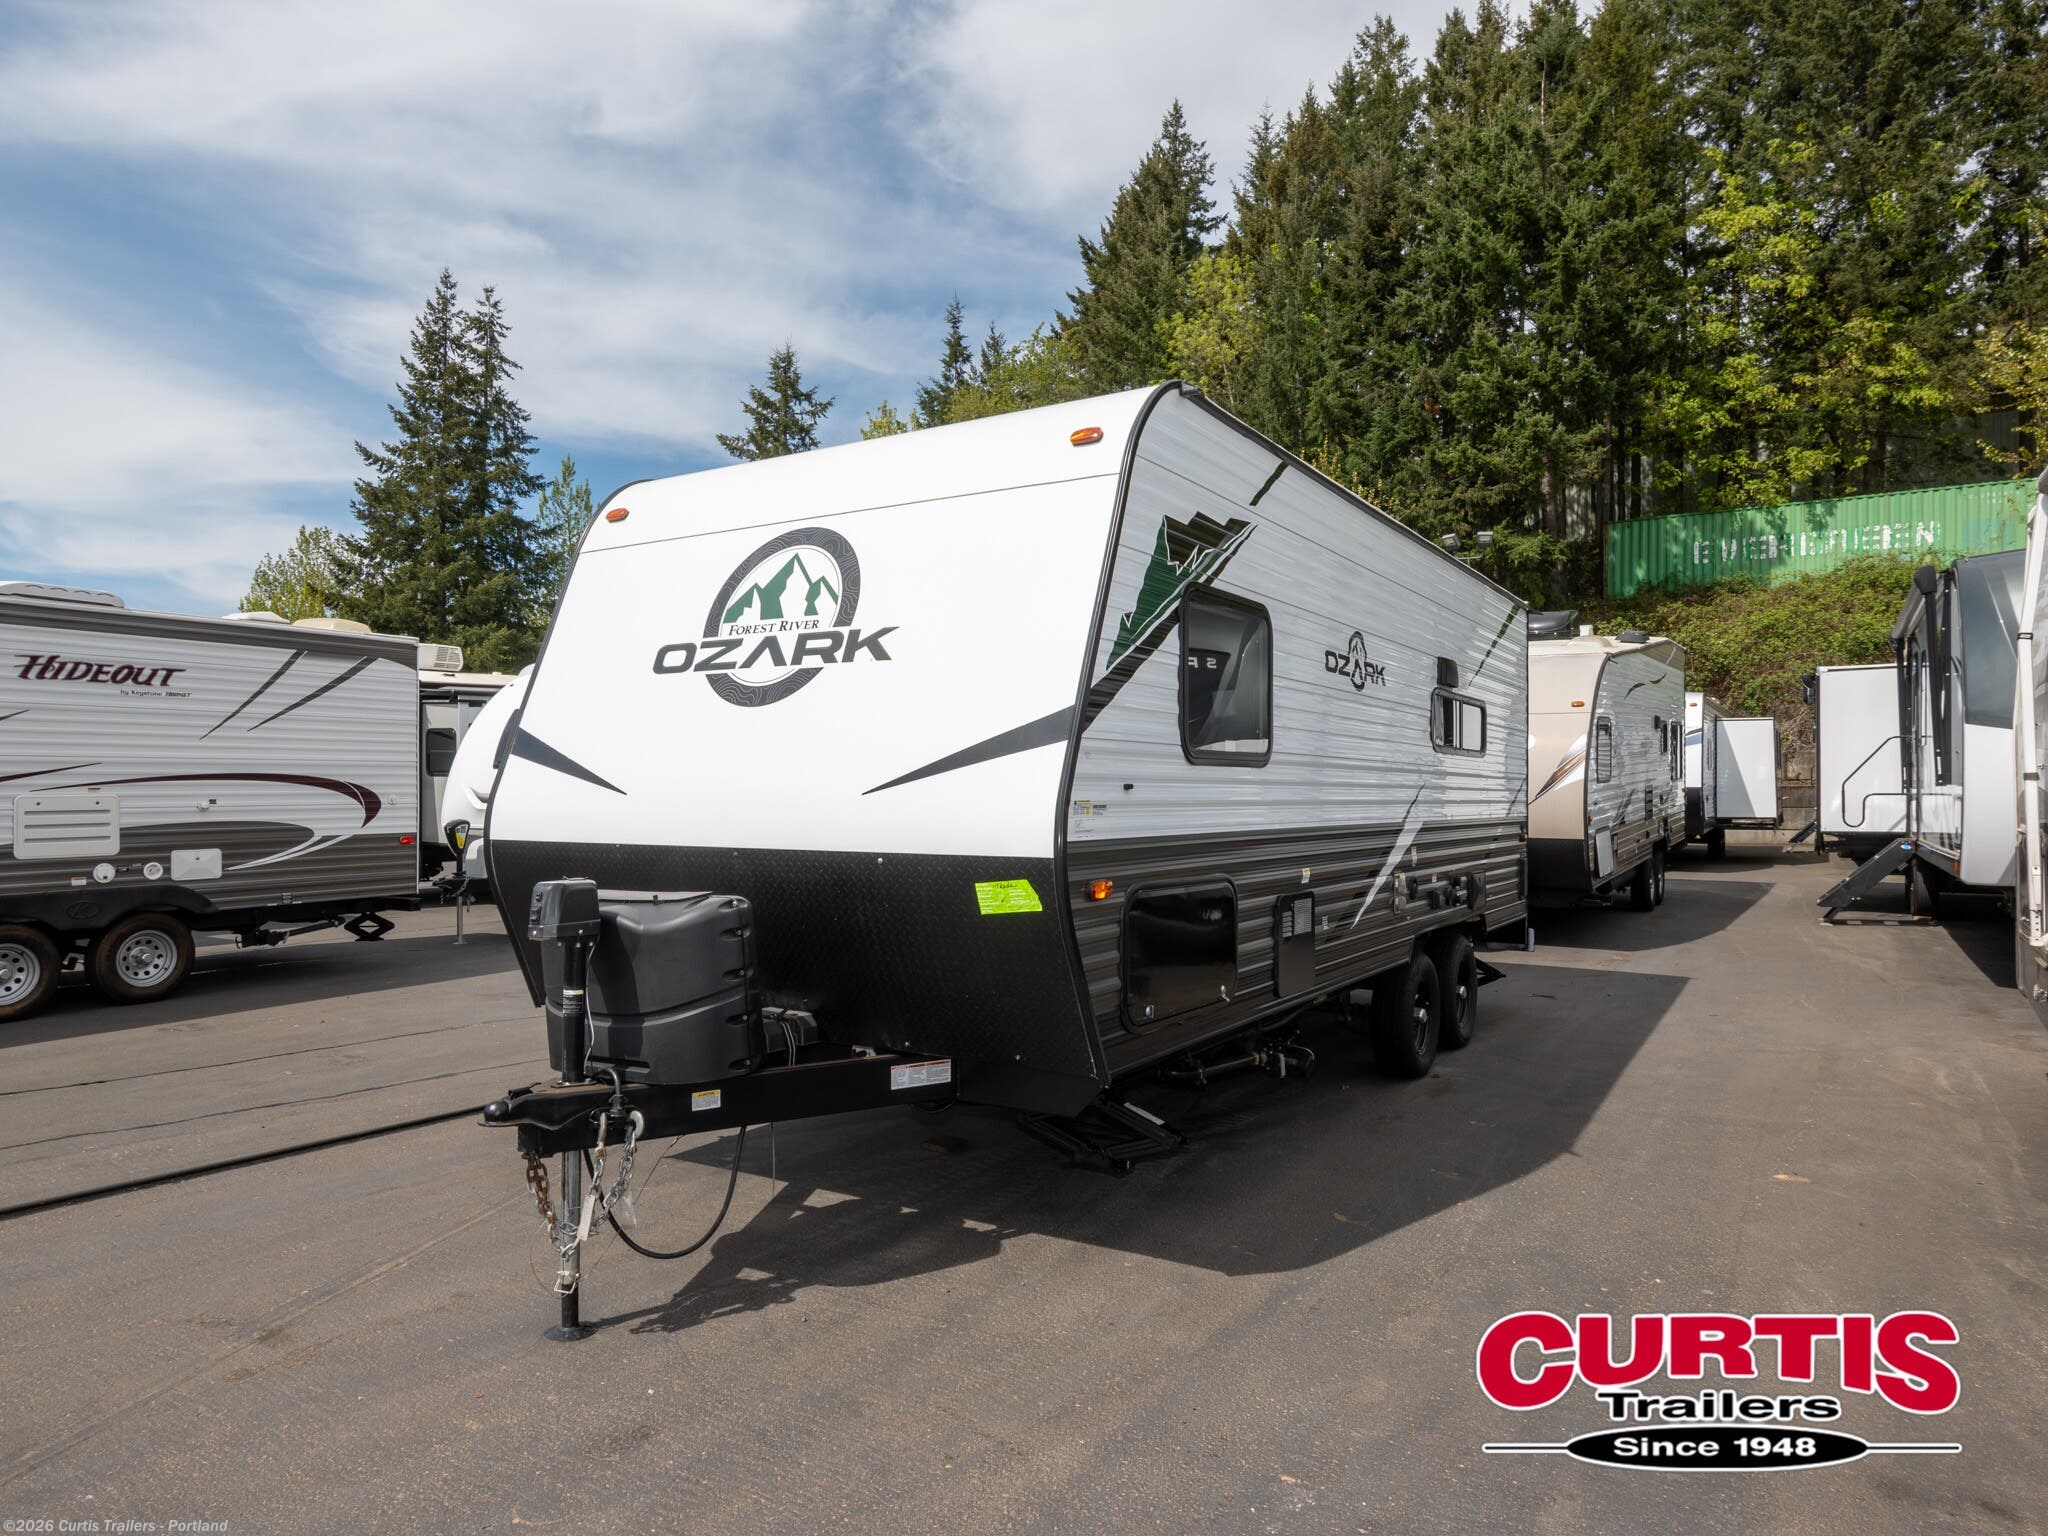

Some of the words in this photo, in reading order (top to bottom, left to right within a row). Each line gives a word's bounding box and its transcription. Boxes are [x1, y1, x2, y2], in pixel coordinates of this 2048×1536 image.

[728, 622, 777, 636] FOREST
[779, 619, 820, 632] RIVER
[652, 626, 900, 675] OZARK
[14, 655, 187, 687] HIDEOUT
[1325, 650, 1386, 687] OZARK
